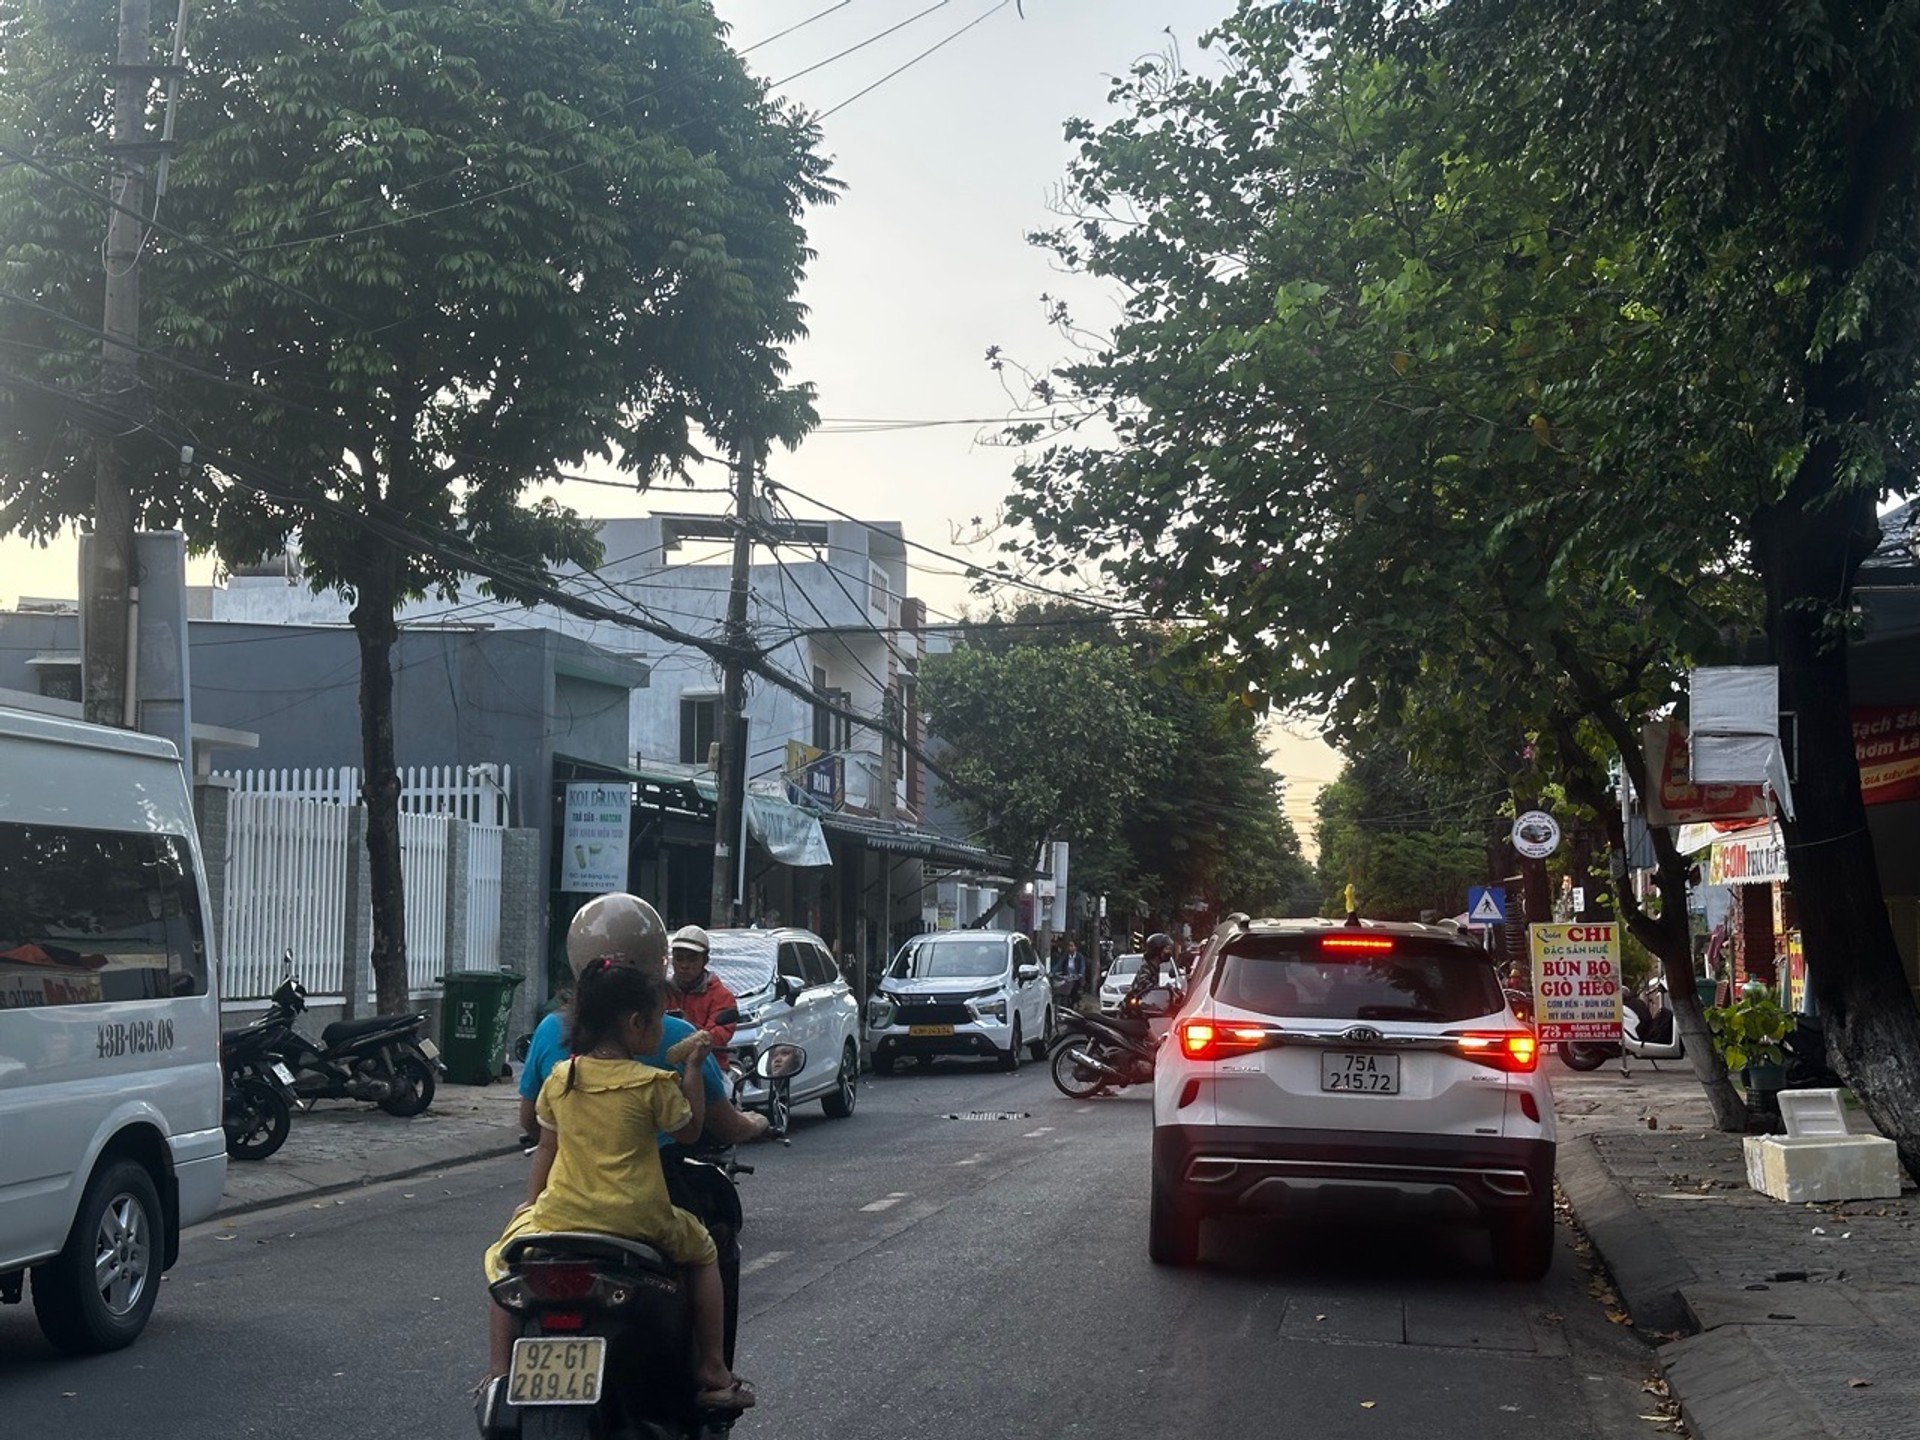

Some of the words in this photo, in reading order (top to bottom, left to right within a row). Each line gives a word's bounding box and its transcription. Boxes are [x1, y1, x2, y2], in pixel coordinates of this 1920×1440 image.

[1856, 742, 1894, 759] hơm
[1567, 927, 1612, 942] CHI
[1542, 956, 1581, 977] BÚN
[1586, 955, 1612, 976] BÒ
[1540, 977, 1573, 997] GIÒ
[1351, 1029, 1374, 1041] KIA
[1541, 1025, 1561, 1038] 73
[1344, 1054, 1377, 1072] 75A
[1329, 1072, 1391, 1091] 215.72
[526, 1342, 589, 1370] 92-G1
[514, 1372, 596, 1399] 289.46
